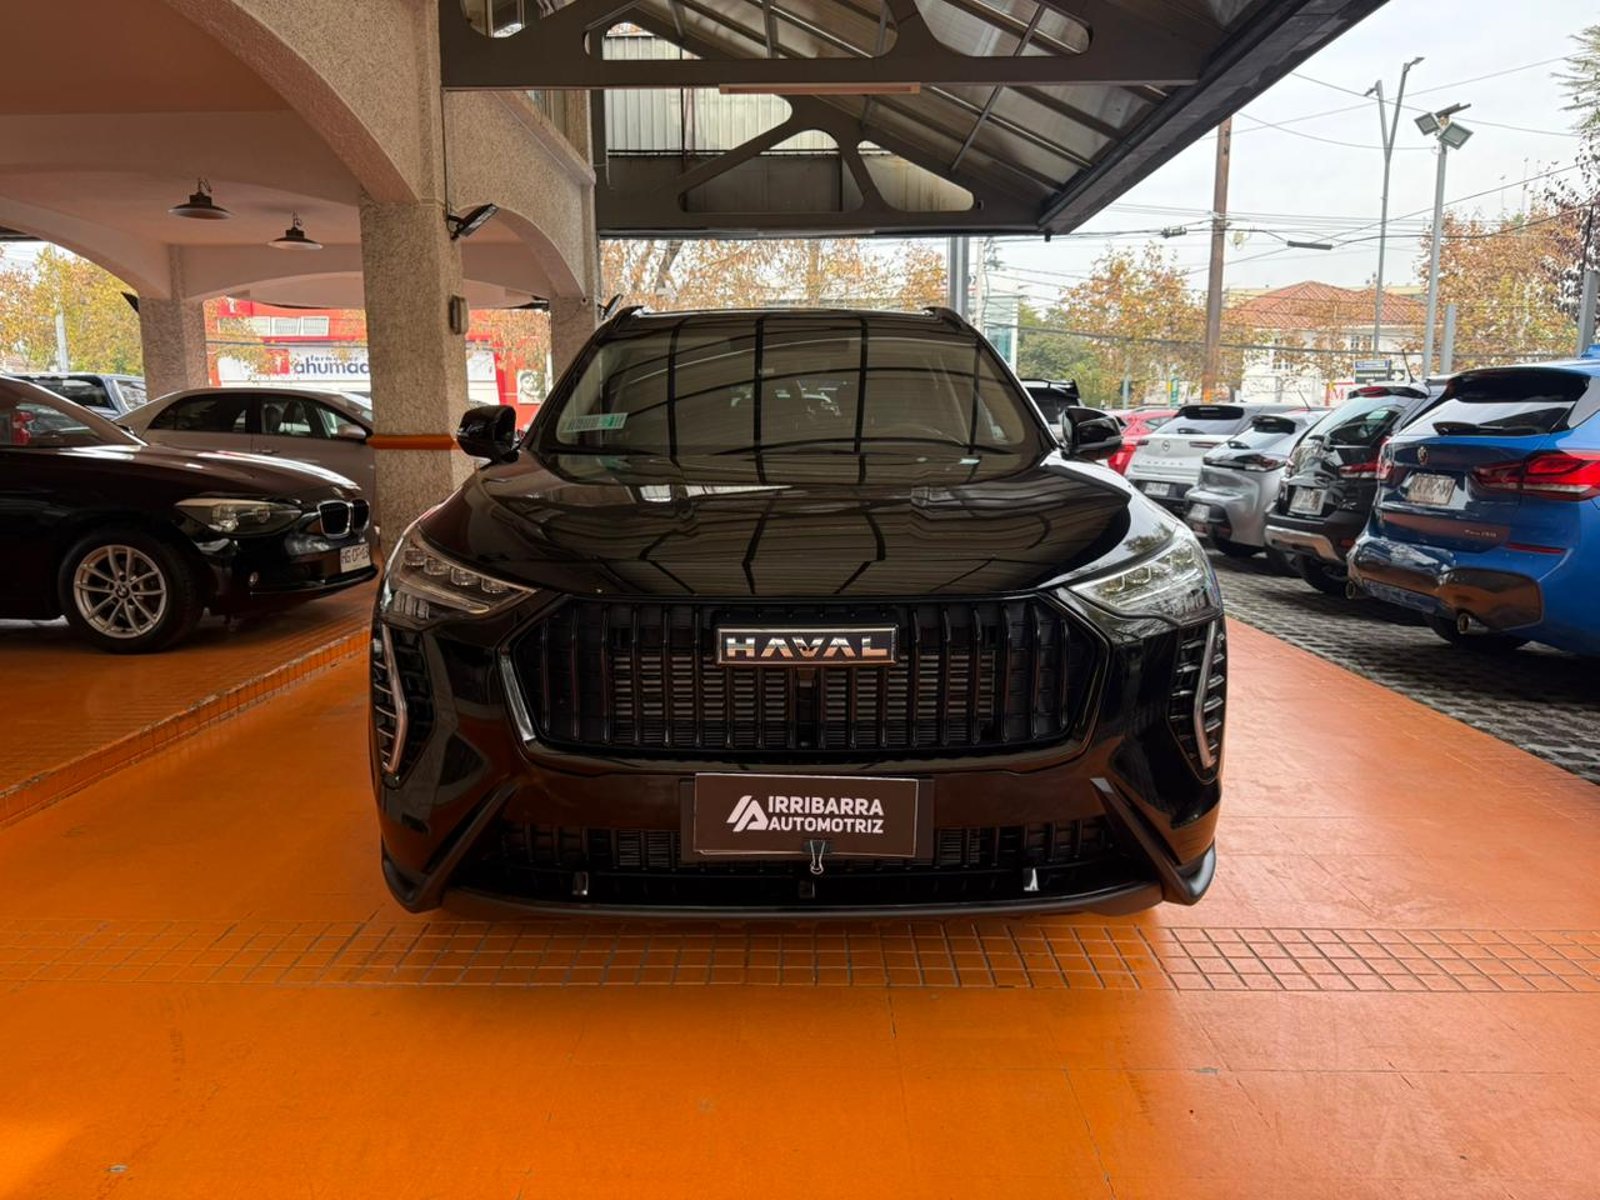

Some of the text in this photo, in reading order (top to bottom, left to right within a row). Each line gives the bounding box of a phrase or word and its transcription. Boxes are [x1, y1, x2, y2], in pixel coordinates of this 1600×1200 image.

[726, 637, 888, 657] HAVAL
[768, 795, 885, 816] IRRIBARRA
[768, 816, 885, 834] AUTOMOTRIZ
